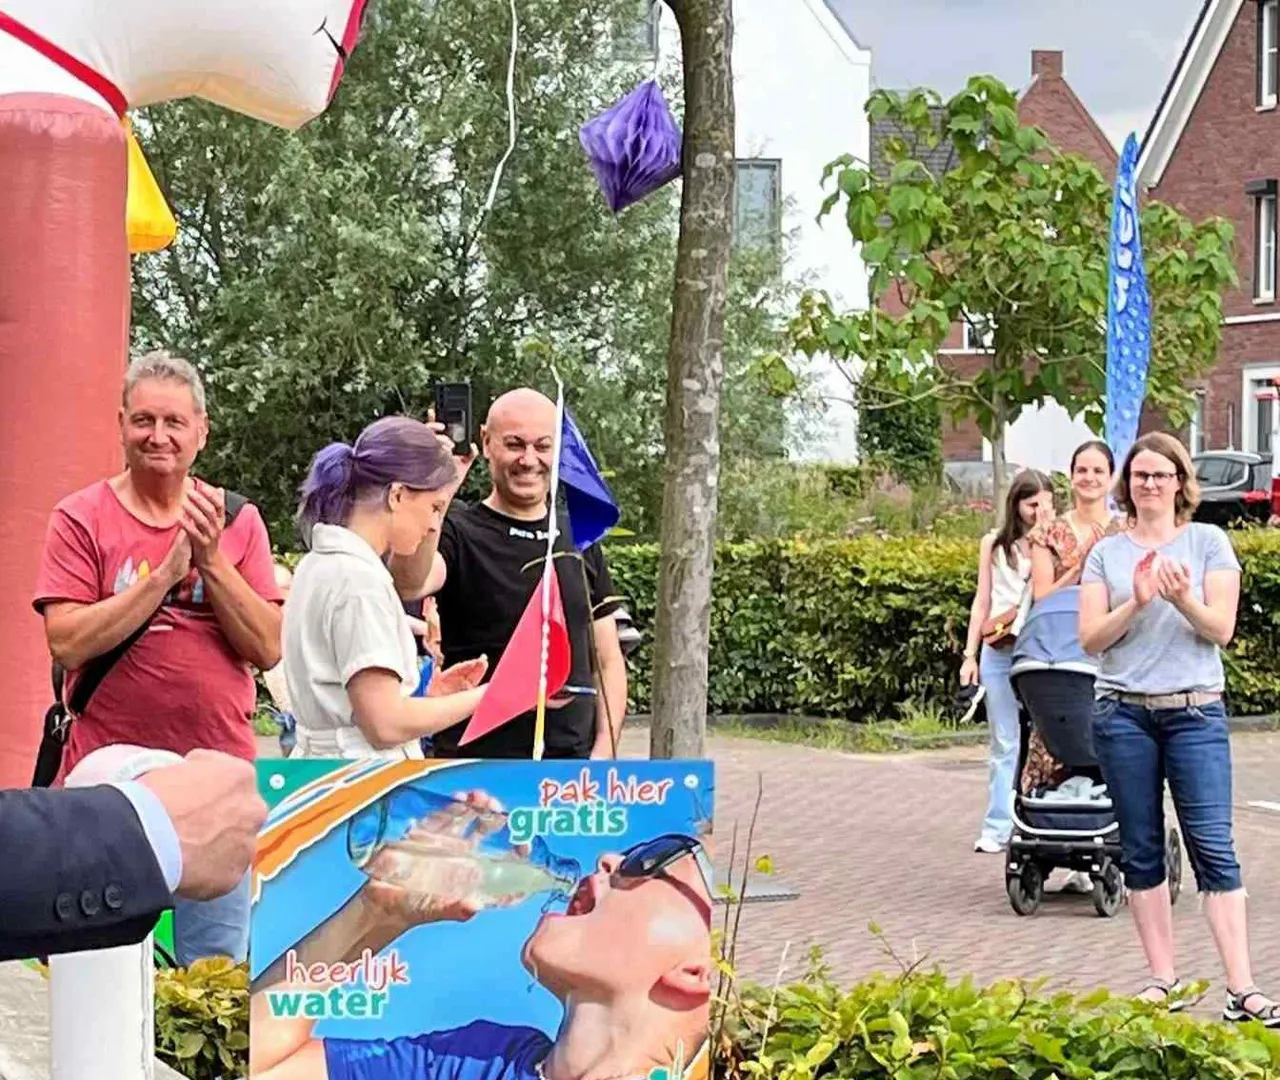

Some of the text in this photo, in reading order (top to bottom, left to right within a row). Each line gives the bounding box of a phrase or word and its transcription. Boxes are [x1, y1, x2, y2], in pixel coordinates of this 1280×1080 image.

[541, 769, 673, 808] pak hier
[509, 800, 627, 844] gratis
[286, 949, 409, 991] heerlijk
[268, 987, 388, 1018] water
